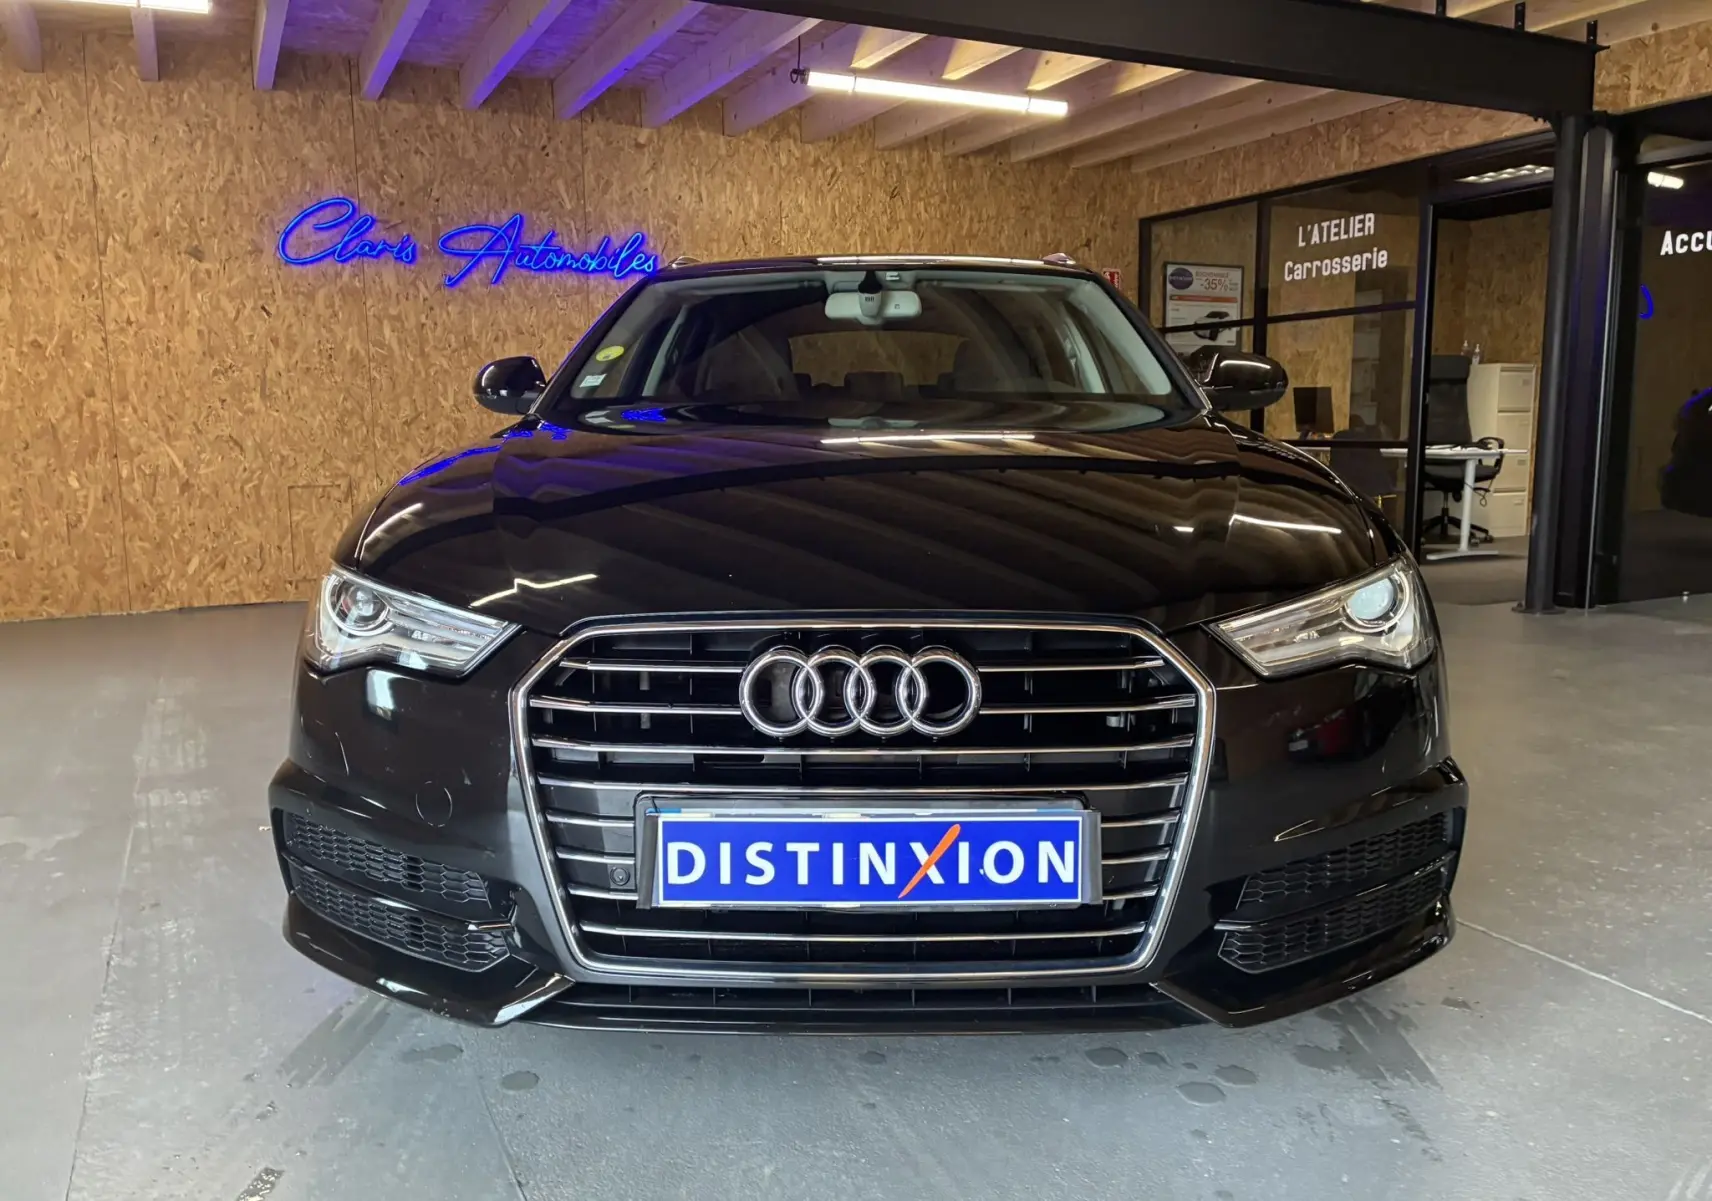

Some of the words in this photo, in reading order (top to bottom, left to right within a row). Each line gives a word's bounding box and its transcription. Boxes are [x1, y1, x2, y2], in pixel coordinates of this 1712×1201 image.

[278, 197, 417, 266] Claris
[437, 212, 657, 287] Automobiles
[1298, 212, 1375, 247] L'ATELIER
[1284, 247, 1388, 281] Carrosserie
[1200, 278, 1229, 292] -35%
[665, 823, 1076, 899] DISTINXION
